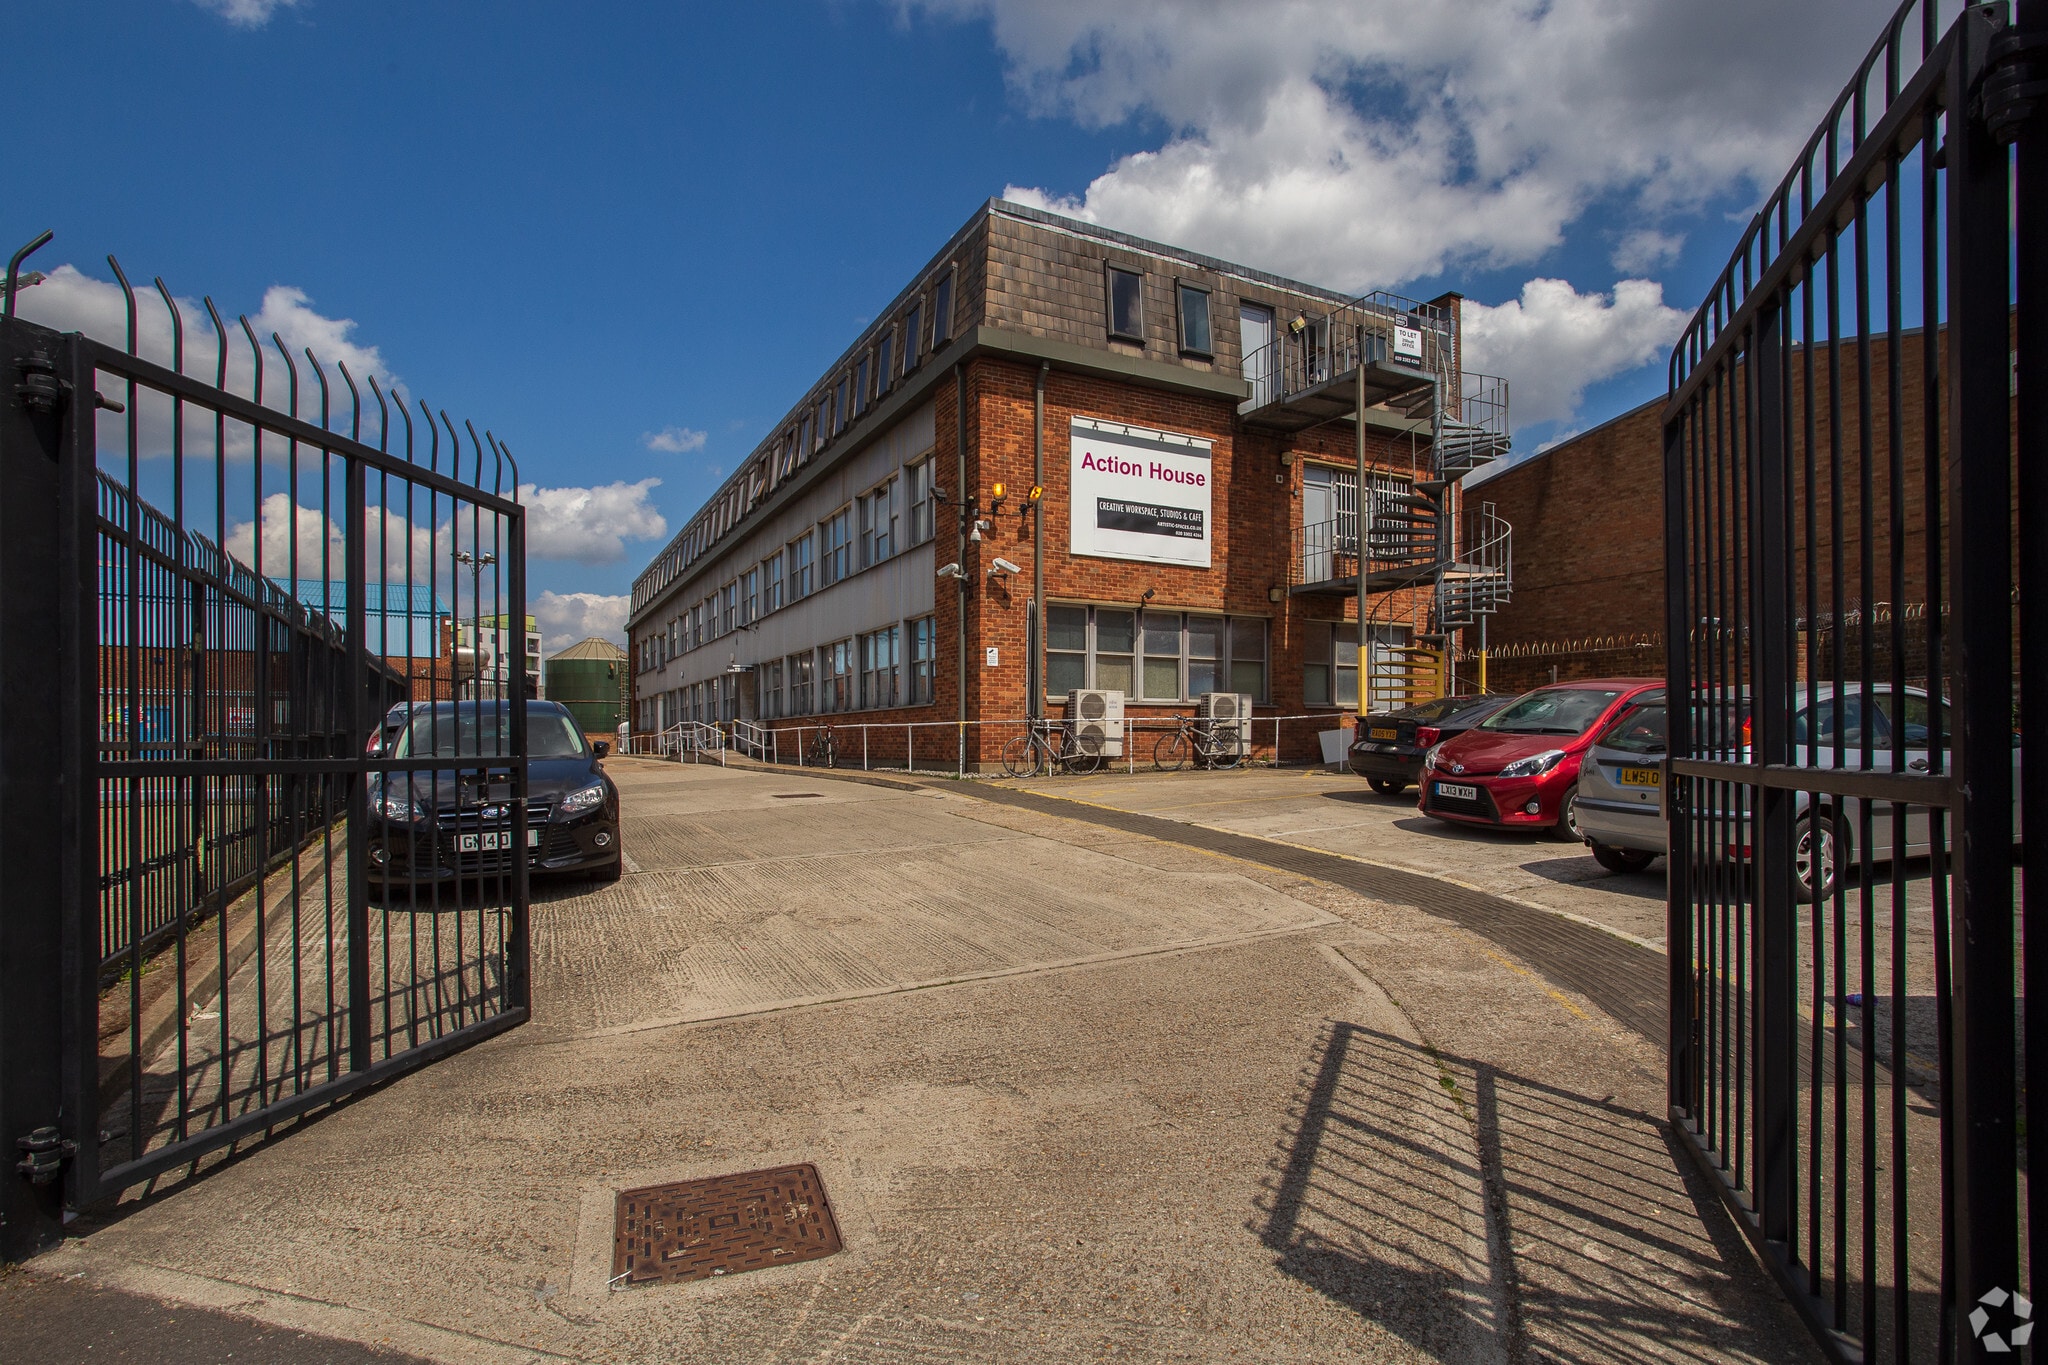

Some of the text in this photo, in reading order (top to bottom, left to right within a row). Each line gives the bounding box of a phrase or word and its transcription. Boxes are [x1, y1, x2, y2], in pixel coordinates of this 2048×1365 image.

[1081, 452, 1206, 486] Action House
[1099, 501, 1202, 522] CREATIVE WORKSPACE, STUDIOS & CAFE
[1441, 784, 1473, 798] LX13 WXH
